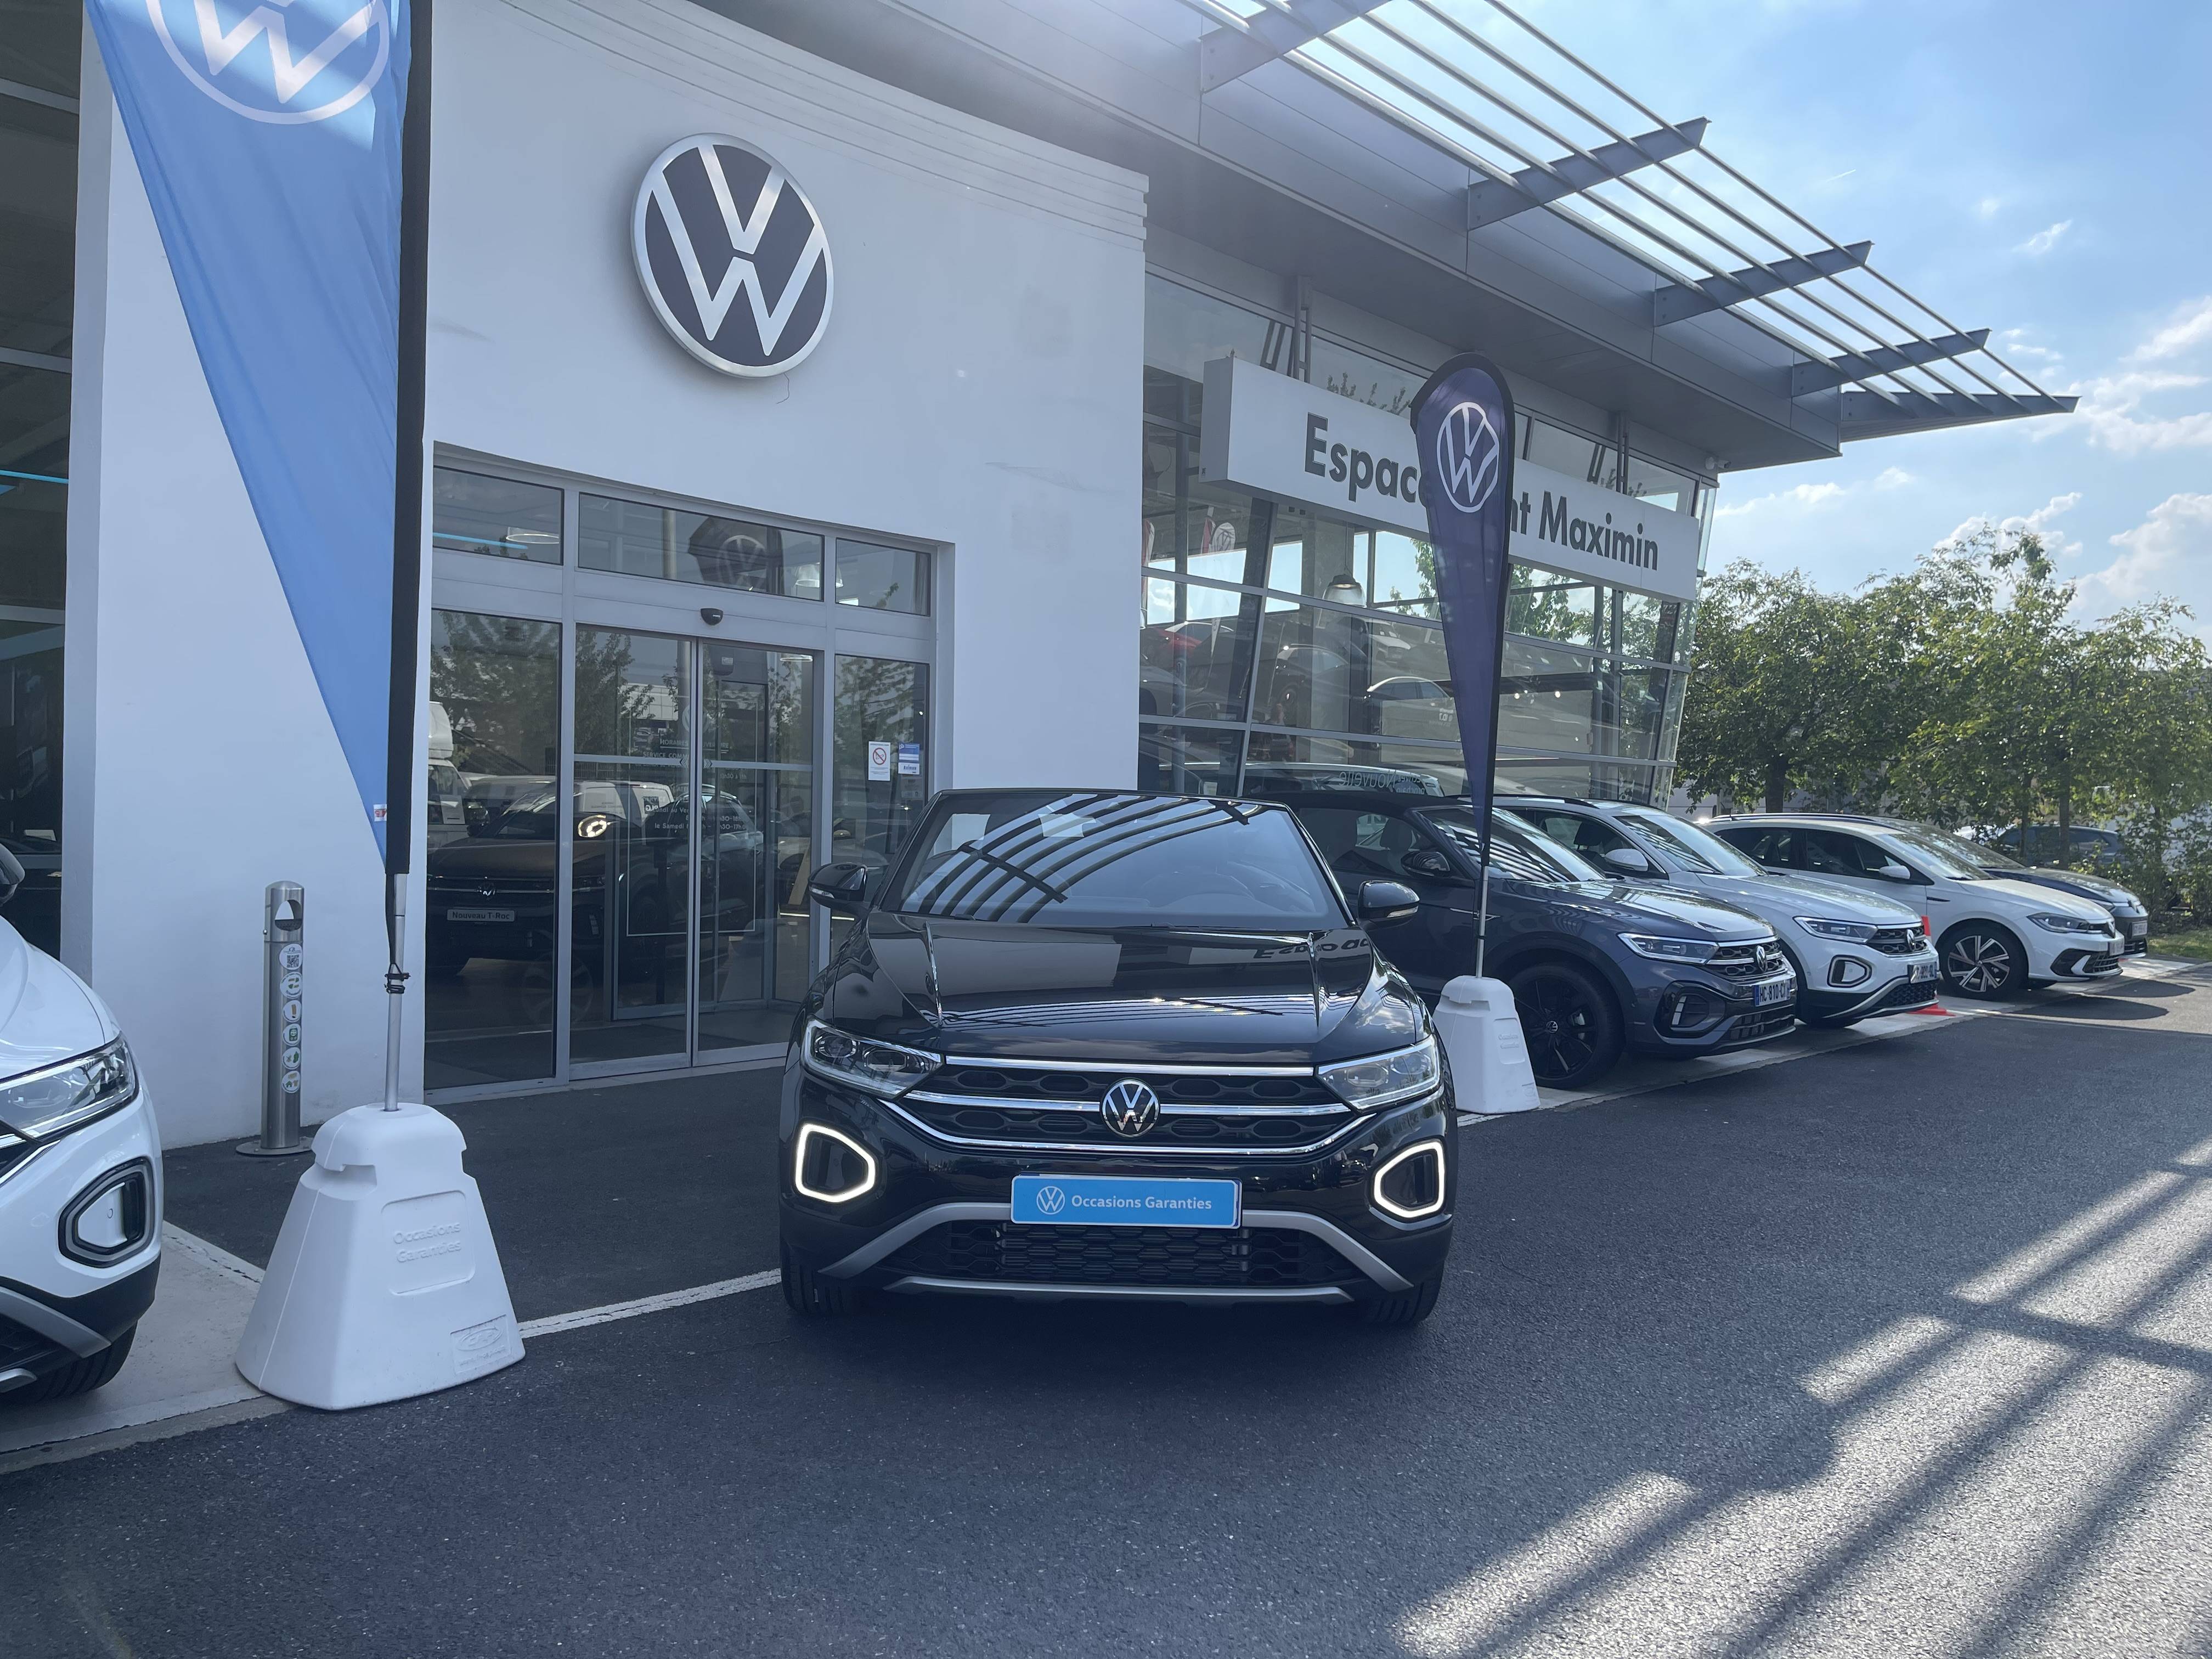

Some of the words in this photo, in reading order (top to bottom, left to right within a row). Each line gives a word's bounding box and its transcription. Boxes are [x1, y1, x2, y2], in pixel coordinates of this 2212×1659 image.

[1539, 490, 1658, 571] Maximin
[1071, 1195, 1141, 1209] Occasions
[1145, 1196, 1212, 1210] Garanties
[393, 1222, 461, 1244] Occasions
